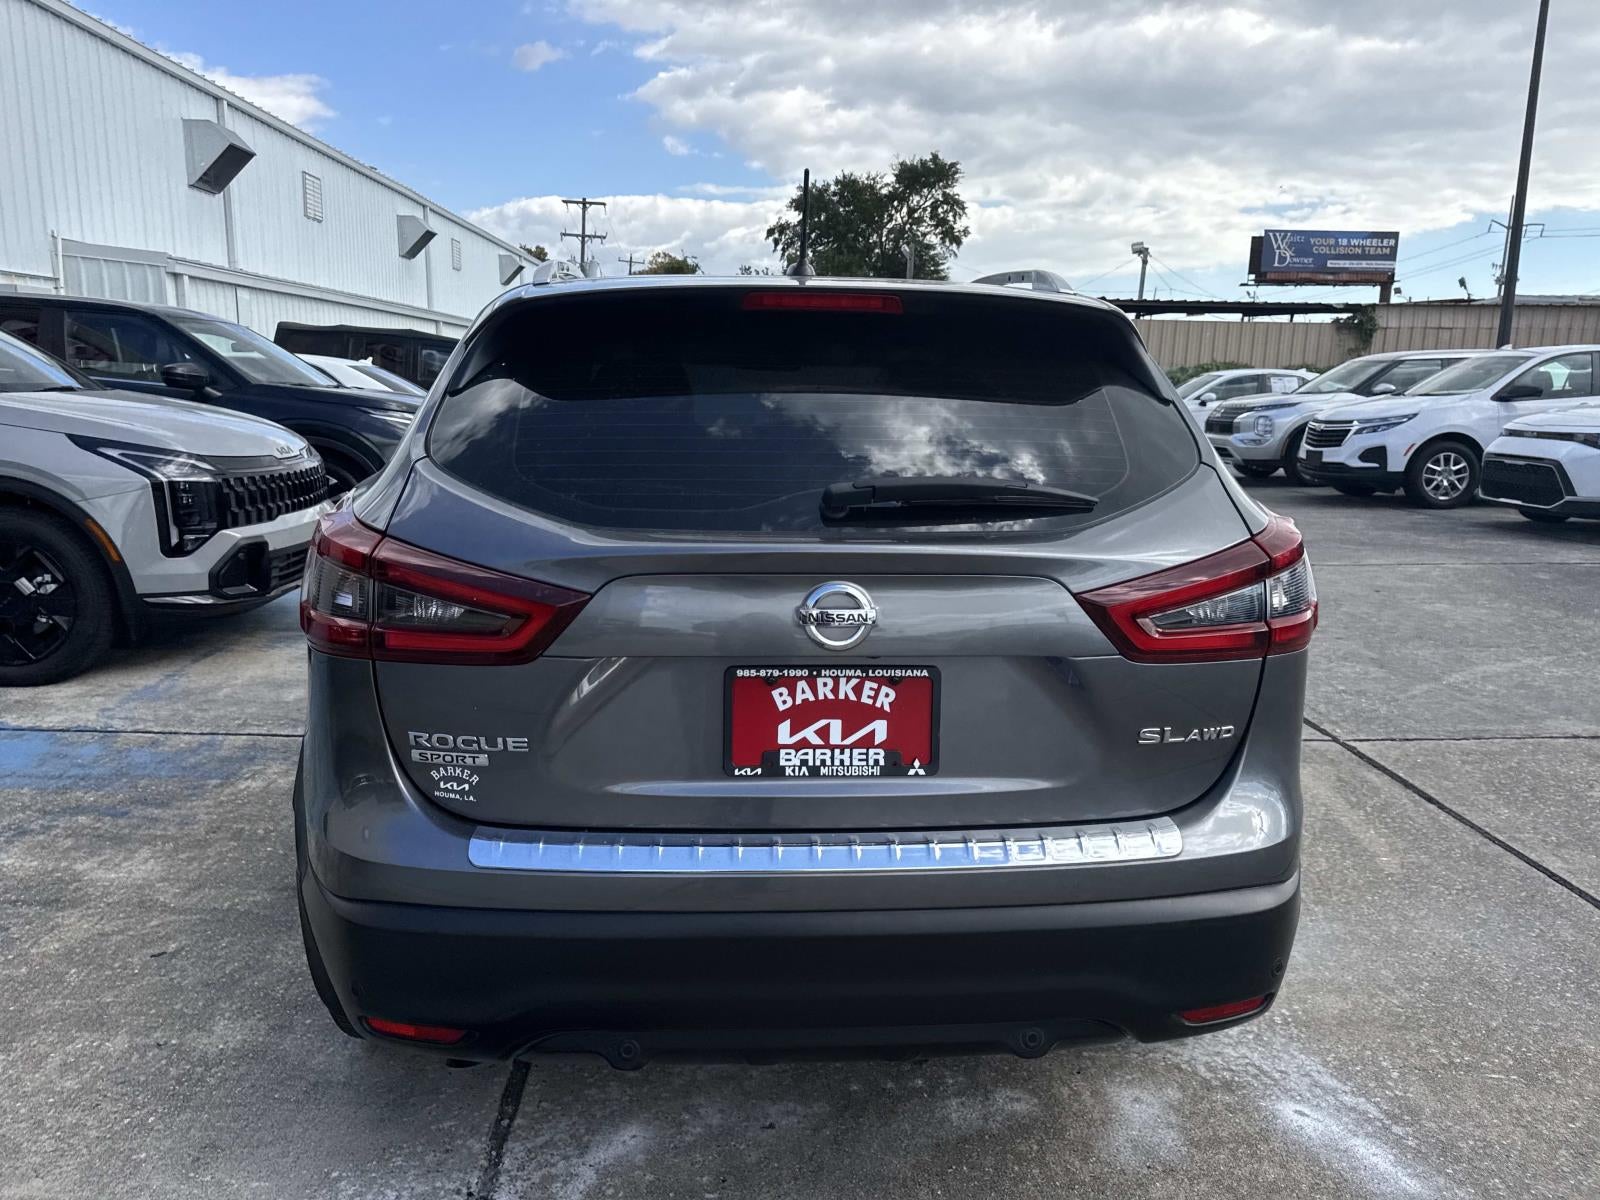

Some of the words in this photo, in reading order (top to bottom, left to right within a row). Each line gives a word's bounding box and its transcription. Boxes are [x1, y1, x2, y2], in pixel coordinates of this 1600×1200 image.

[1310, 238, 1336, 246] YOUR
[1338, 238, 1349, 246] 18
[1350, 238, 1396, 247] WHEELER
[1312, 247, 1362, 255] COLLISION
[1364, 247, 1390, 255] TEAM
[808, 613, 868, 623] NISSAN
[736, 669, 809, 677] 985-879-1990
[821, 669, 866, 678] HOUMA,
[868, 669, 929, 677] LOUISIANA
[771, 677, 896, 712] BARKER
[777, 718, 888, 746] KIA
[1138, 727, 1185, 744] SL
[1185, 725, 1234, 743] AWD
[408, 731, 529, 752] ROGUE
[418, 752, 480, 765] SPORT
[779, 748, 885, 766] BARKER
[430, 766, 480, 786] BARKER
[734, 767, 762, 776] KIA
[785, 766, 809, 776] KIA
[820, 766, 880, 776] MITSUBISHI
[440, 780, 470, 792] KIA
[434, 790, 463, 801] HOUMA,
